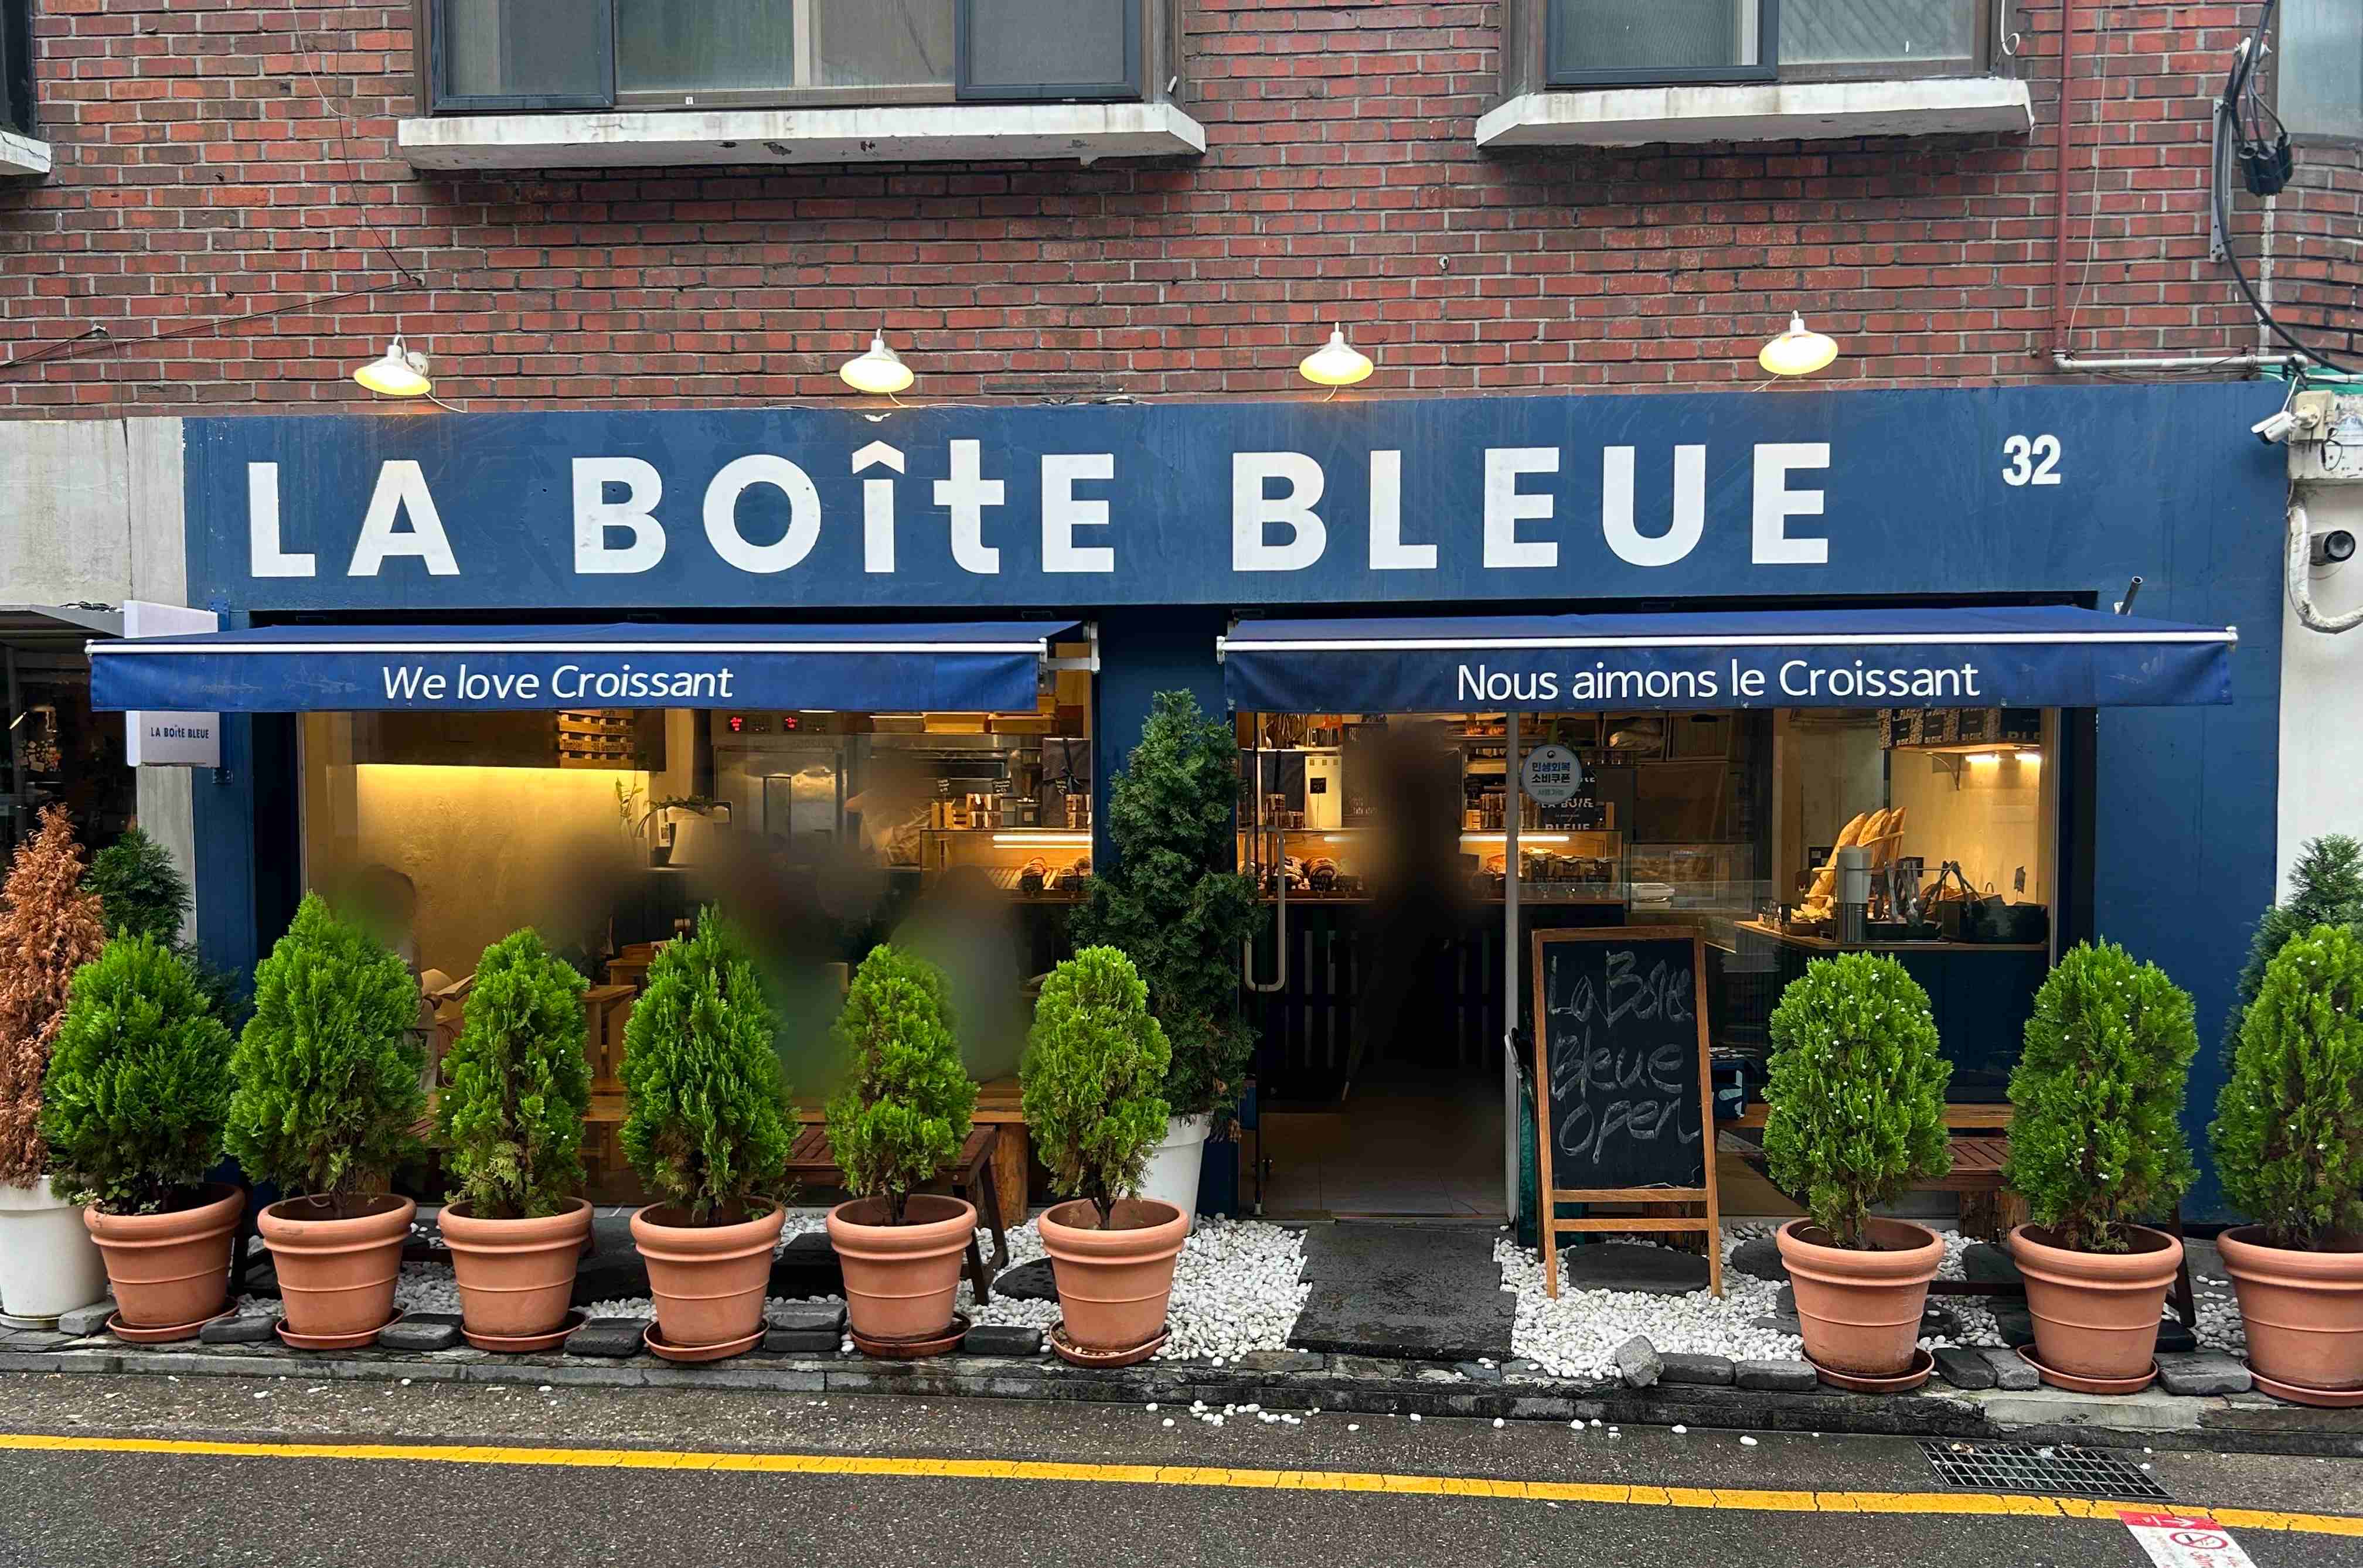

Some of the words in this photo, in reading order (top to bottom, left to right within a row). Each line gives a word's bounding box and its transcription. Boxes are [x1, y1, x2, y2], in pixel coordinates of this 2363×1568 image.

[2002, 434, 2062, 486] 32
[248, 459, 460, 577] LA
[1232, 442, 1830, 571] BLEUE
[383, 666, 447, 699] We
[458, 664, 540, 700] love
[552, 663, 734, 698] Croissant
[1458, 664, 1559, 701] Nous
[1572, 662, 1718, 700] aimons
[1731, 659, 1766, 696] le
[1779, 658, 1981, 697] Croissant
[151, 727, 161, 737] LA
[188, 728, 210, 739] BLEUE
[1531, 773, 1571, 783] 소비쿠폰
